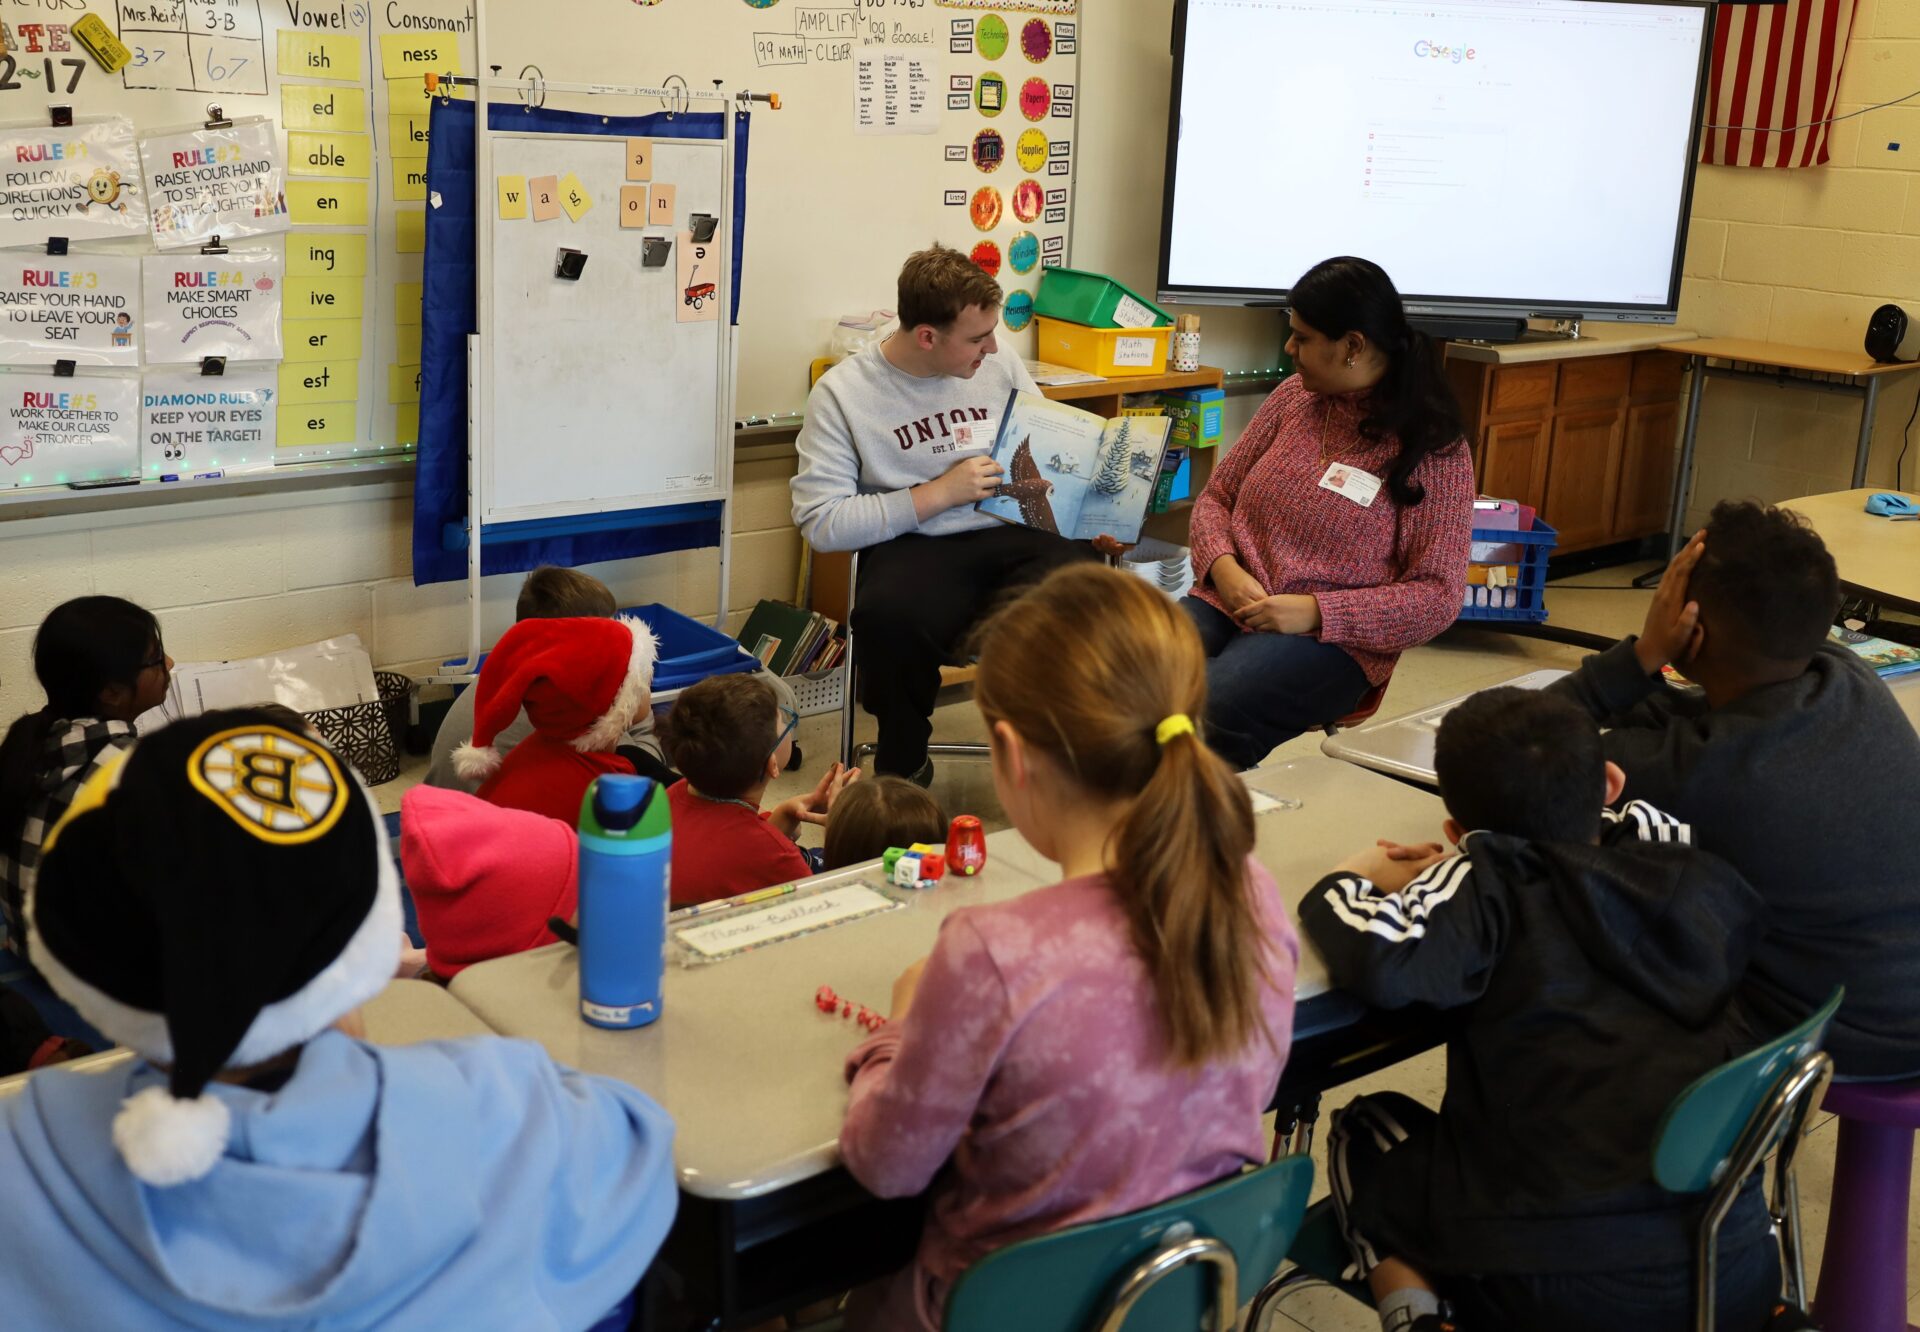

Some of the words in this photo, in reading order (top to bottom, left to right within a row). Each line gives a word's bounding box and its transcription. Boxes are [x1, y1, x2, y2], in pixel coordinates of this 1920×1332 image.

[150, 5, 184, 30] Reidy
[206, 10, 235, 31] 3-B
[286, 0, 346, 29] Vowel
[386, 1, 474, 33] Consonant
[798, 11, 856, 32] AMPLIFY
[869, 14, 886, 38] log
[893, 21, 901, 34] in
[0, 22, 71, 52] ATE
[863, 32, 885, 46] with
[132, 46, 165, 66] 37
[308, 46, 330, 68] ish
[403, 49, 438, 62] ness
[758, 40, 773, 60] 99
[779, 45, 804, 59] MATH
[815, 42, 852, 62] CLEVER
[207, 47, 248, 81] 67
[313, 94, 334, 115] ed
[1025, 92, 1045, 105] Papers
[410, 121, 430, 142] les
[308, 144, 345, 166] able
[1021, 144, 1044, 156] Supplies
[6, 169, 67, 187] FOLLOW
[154, 170, 191, 188] RAISE
[192, 165, 231, 182] YOUR
[232, 160, 271, 177] HAND
[163, 189, 183, 203] TO
[185, 182, 230, 200] SHARE
[316, 197, 338, 209] en
[12, 204, 72, 221] QUICKLY
[309, 247, 335, 271] ing
[40, 293, 81, 307] YOUR
[84, 294, 126, 309] HAND
[167, 290, 204, 304] MAKE
[207, 289, 252, 303] SMART
[311, 291, 335, 305] ive
[6, 308, 27, 322] TO
[31, 309, 74, 324] LEAVE
[76, 311, 116, 325] YOUR
[182, 305, 238, 319] CHOICES
[1118, 308, 1145, 328] Station
[44, 326, 80, 340] SEAT
[308, 334, 327, 346] er
[1120, 339, 1142, 349] Math
[303, 367, 330, 388] est
[144, 393, 217, 407] DIAMOND
[10, 408, 45, 419] WORK
[46, 408, 101, 421] TOGETHER
[103, 411, 119, 422] TO
[150, 411, 185, 424] KEEP
[187, 410, 226, 423] YOUR
[229, 409, 262, 422] EYES
[1164, 403, 1191, 419] icky
[18, 420, 49, 431] MAKE
[51, 421, 75, 432] OUR
[77, 422, 110, 434] CLASS
[307, 418, 326, 430] es
[893, 407, 988, 450] UNION
[35, 433, 93, 445] STRONGER
[150, 432, 172, 445] ON
[175, 430, 203, 443] THE
[206, 428, 261, 442] TARGET!
[932, 444, 947, 454] EST.
